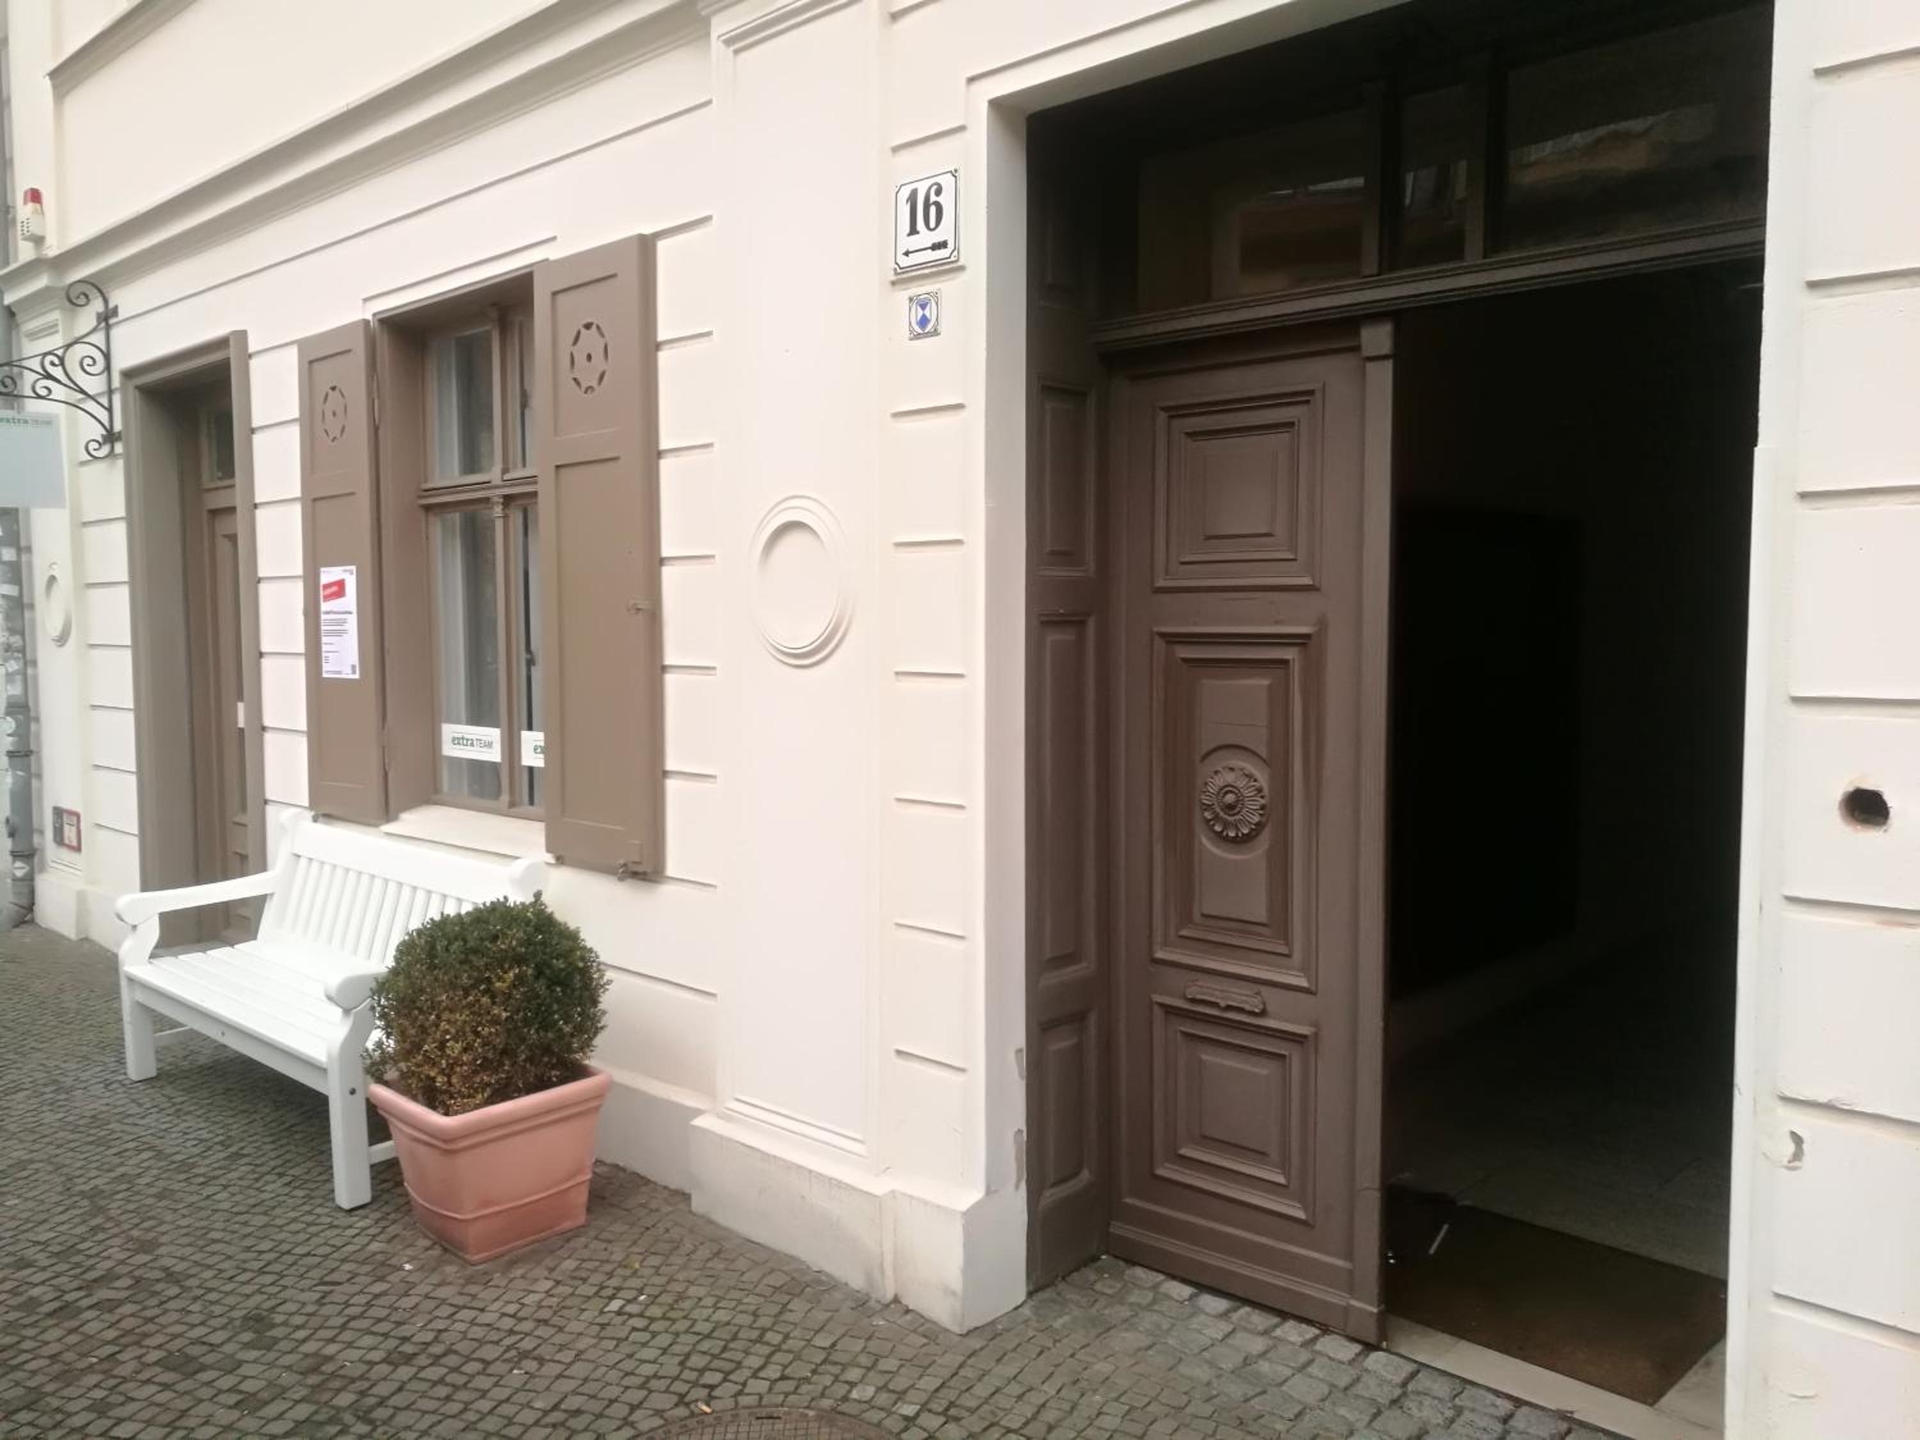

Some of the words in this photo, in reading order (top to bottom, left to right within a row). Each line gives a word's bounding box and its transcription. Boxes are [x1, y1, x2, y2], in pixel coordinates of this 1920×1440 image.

[905, 182, 943, 238] 16
[451, 735, 475, 748] extra
[475, 738, 494, 749] TEAM
[533, 744, 545, 754] ex
